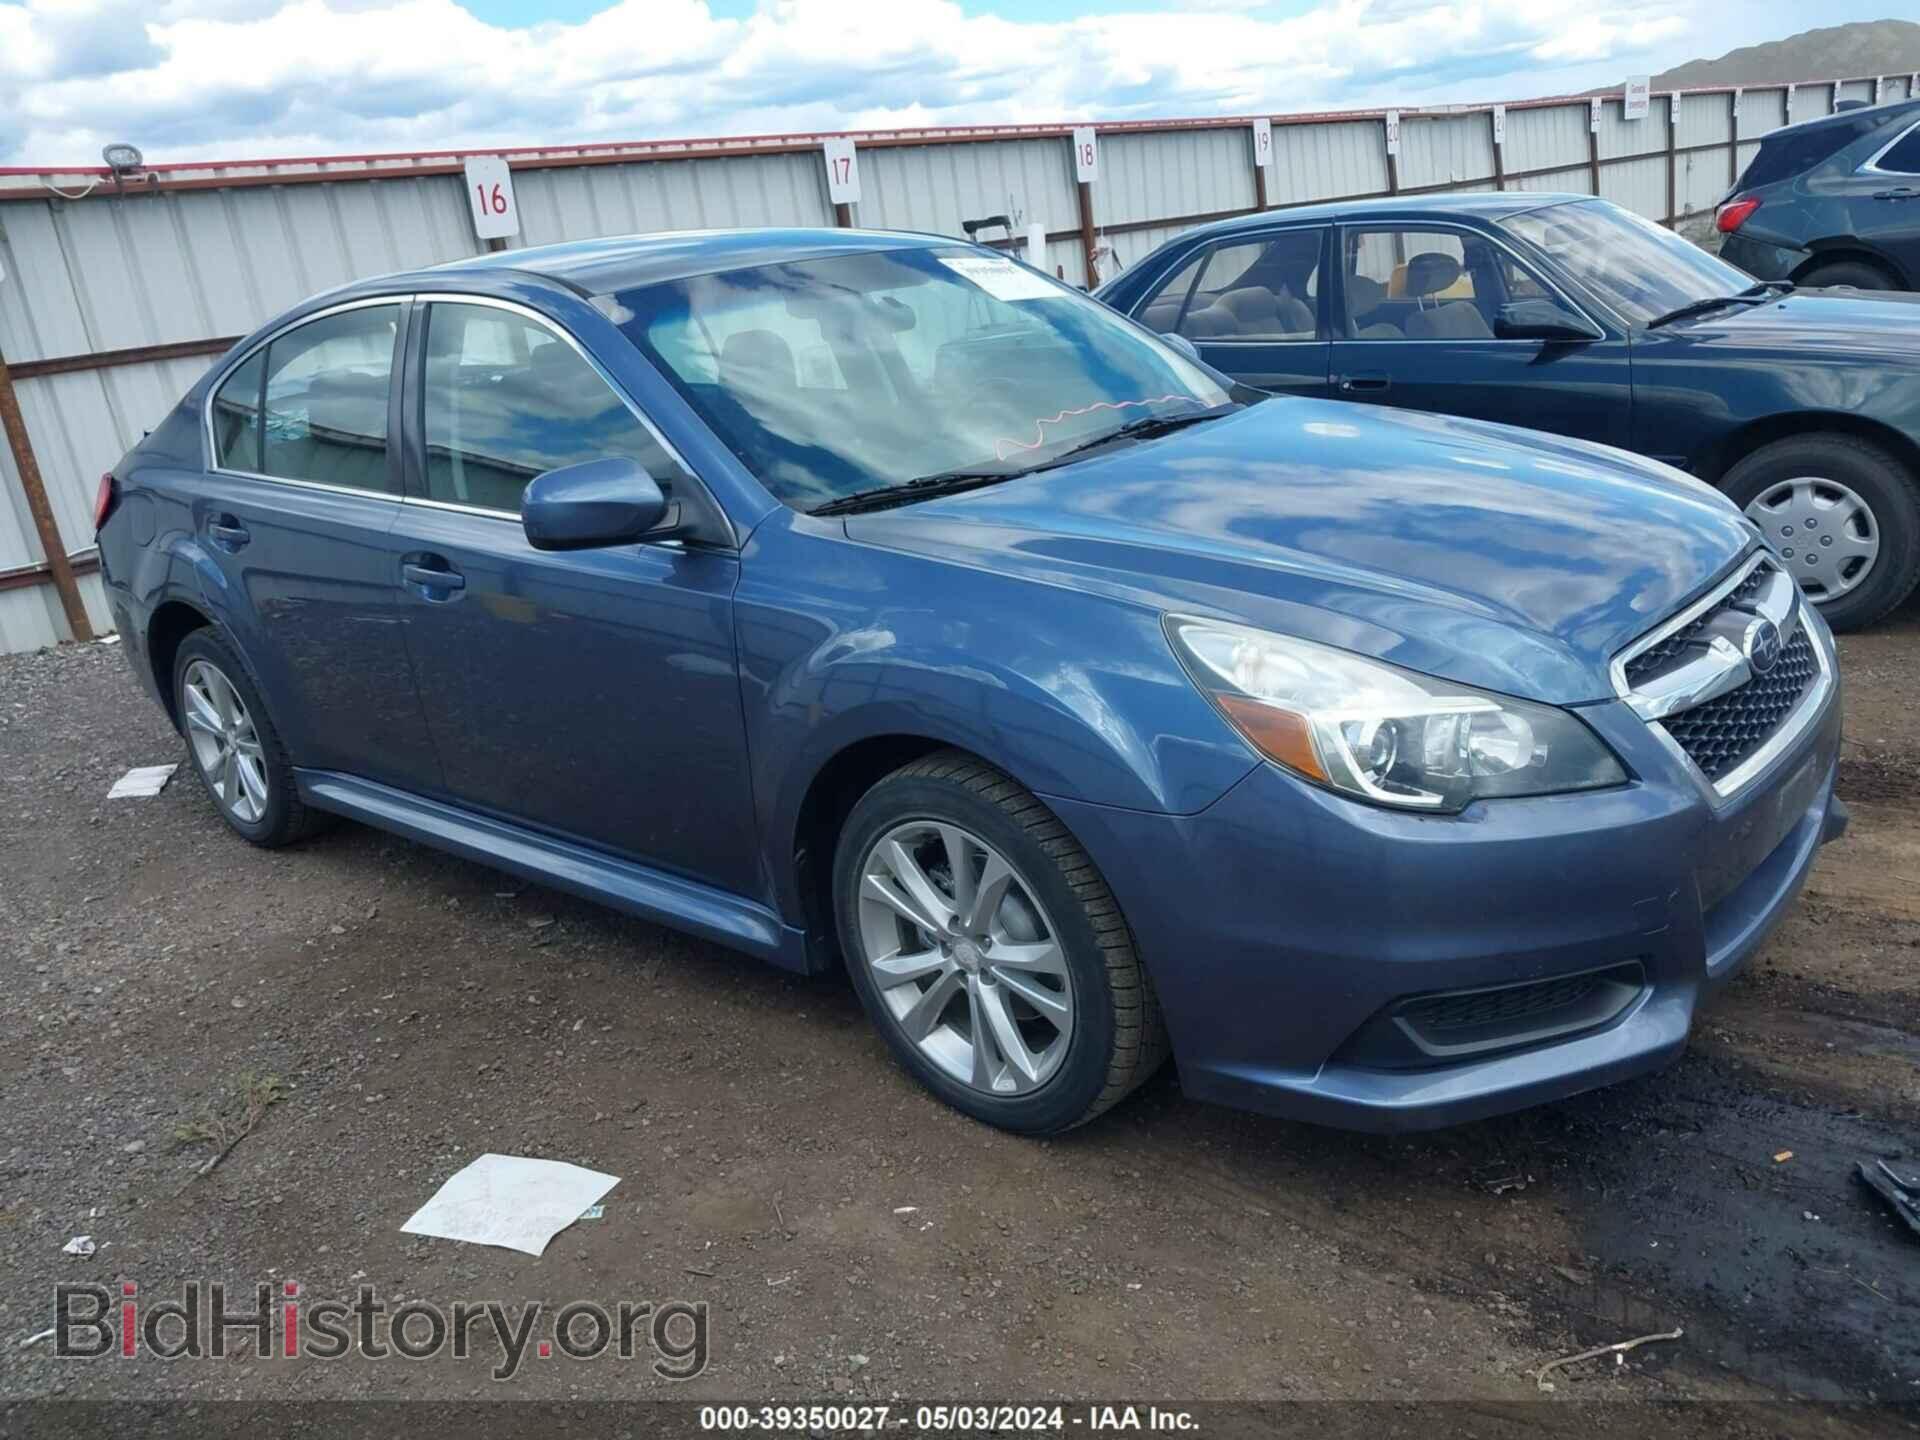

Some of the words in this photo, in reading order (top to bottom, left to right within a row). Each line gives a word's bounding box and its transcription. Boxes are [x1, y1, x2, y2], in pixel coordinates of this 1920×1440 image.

[1257, 132, 1269, 151] 19
[1079, 143, 1094, 168] 18
[831, 157, 852, 185] 17
[476, 183, 507, 216] 16
